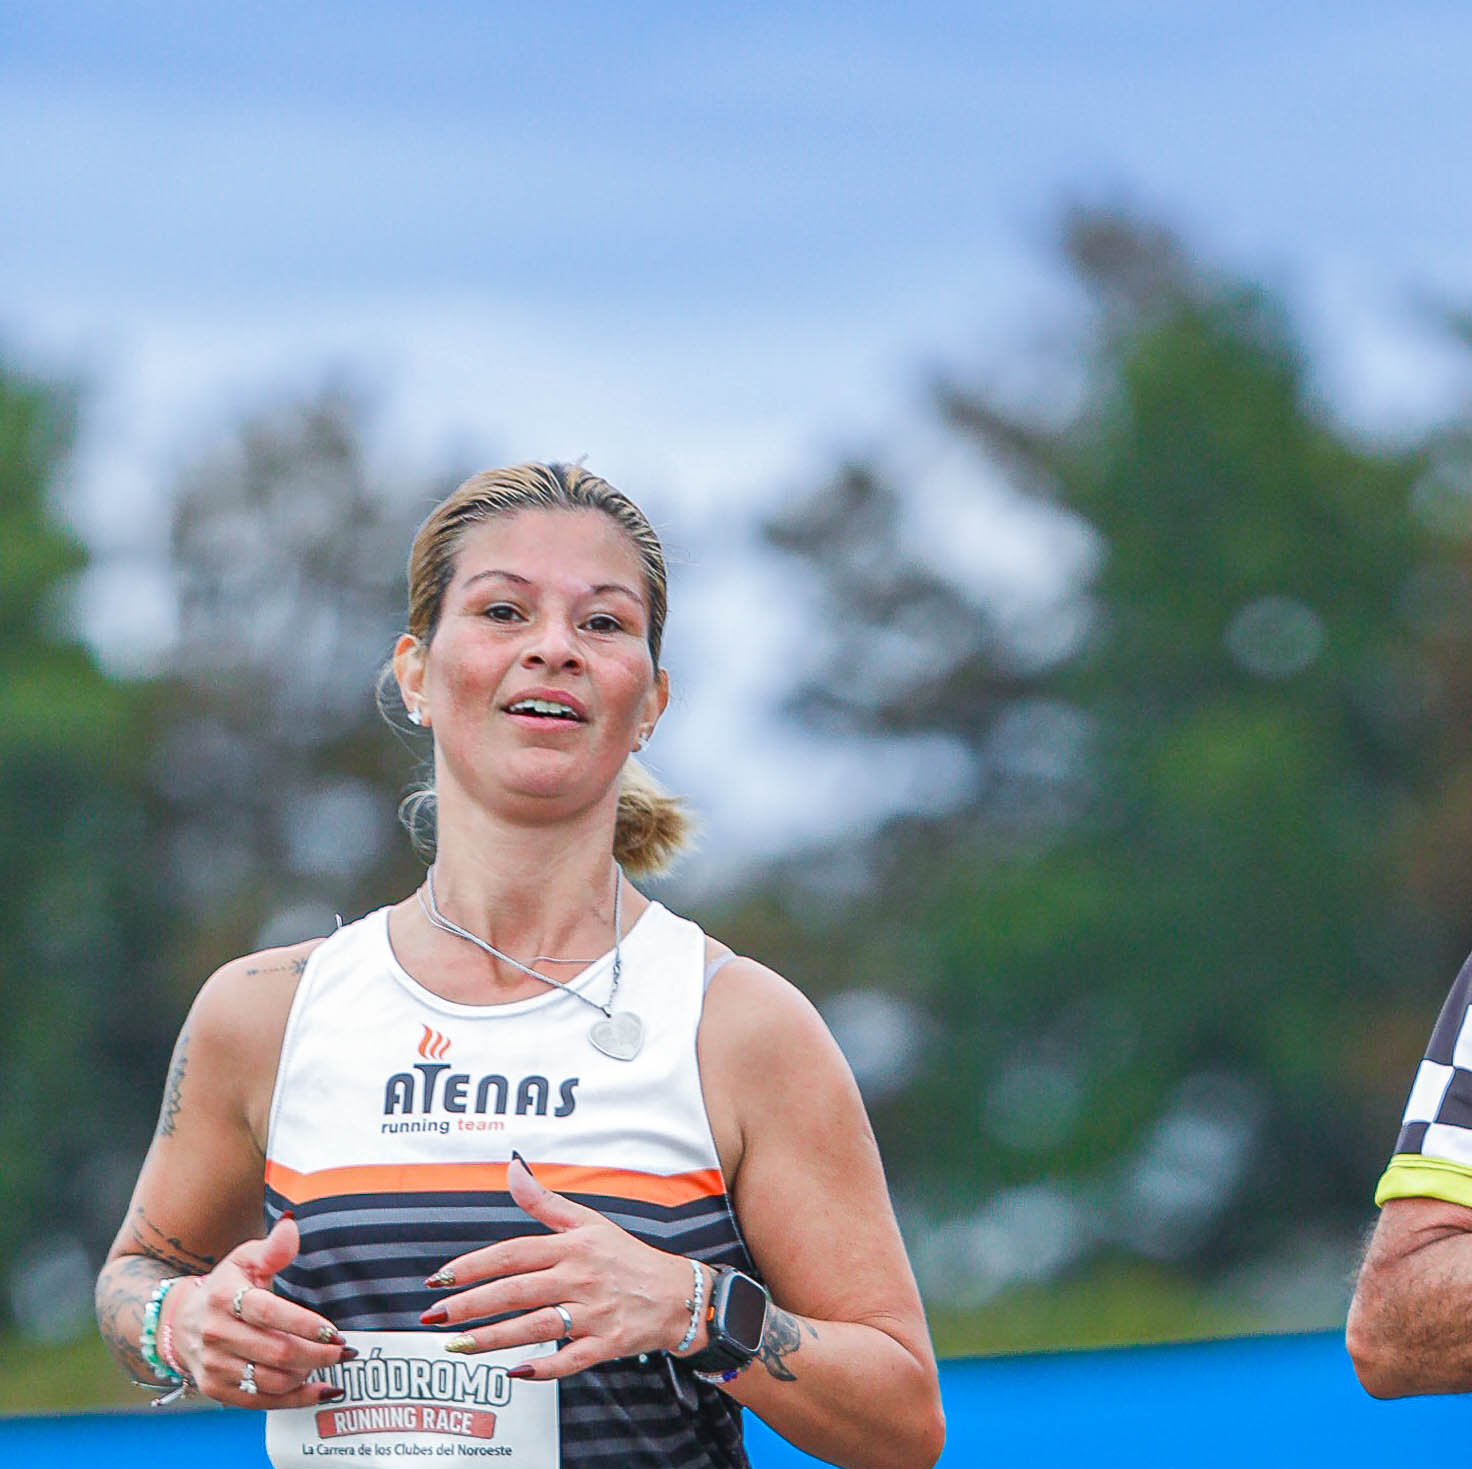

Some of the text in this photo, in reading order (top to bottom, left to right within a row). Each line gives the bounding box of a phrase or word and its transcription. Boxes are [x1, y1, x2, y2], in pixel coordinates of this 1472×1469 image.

[381, 1119, 505, 1135] running team
[333, 1406, 474, 1435] RUNNING RACE
[302, 1442, 512, 1456] La Carrera de los Clubes del Noroeste
